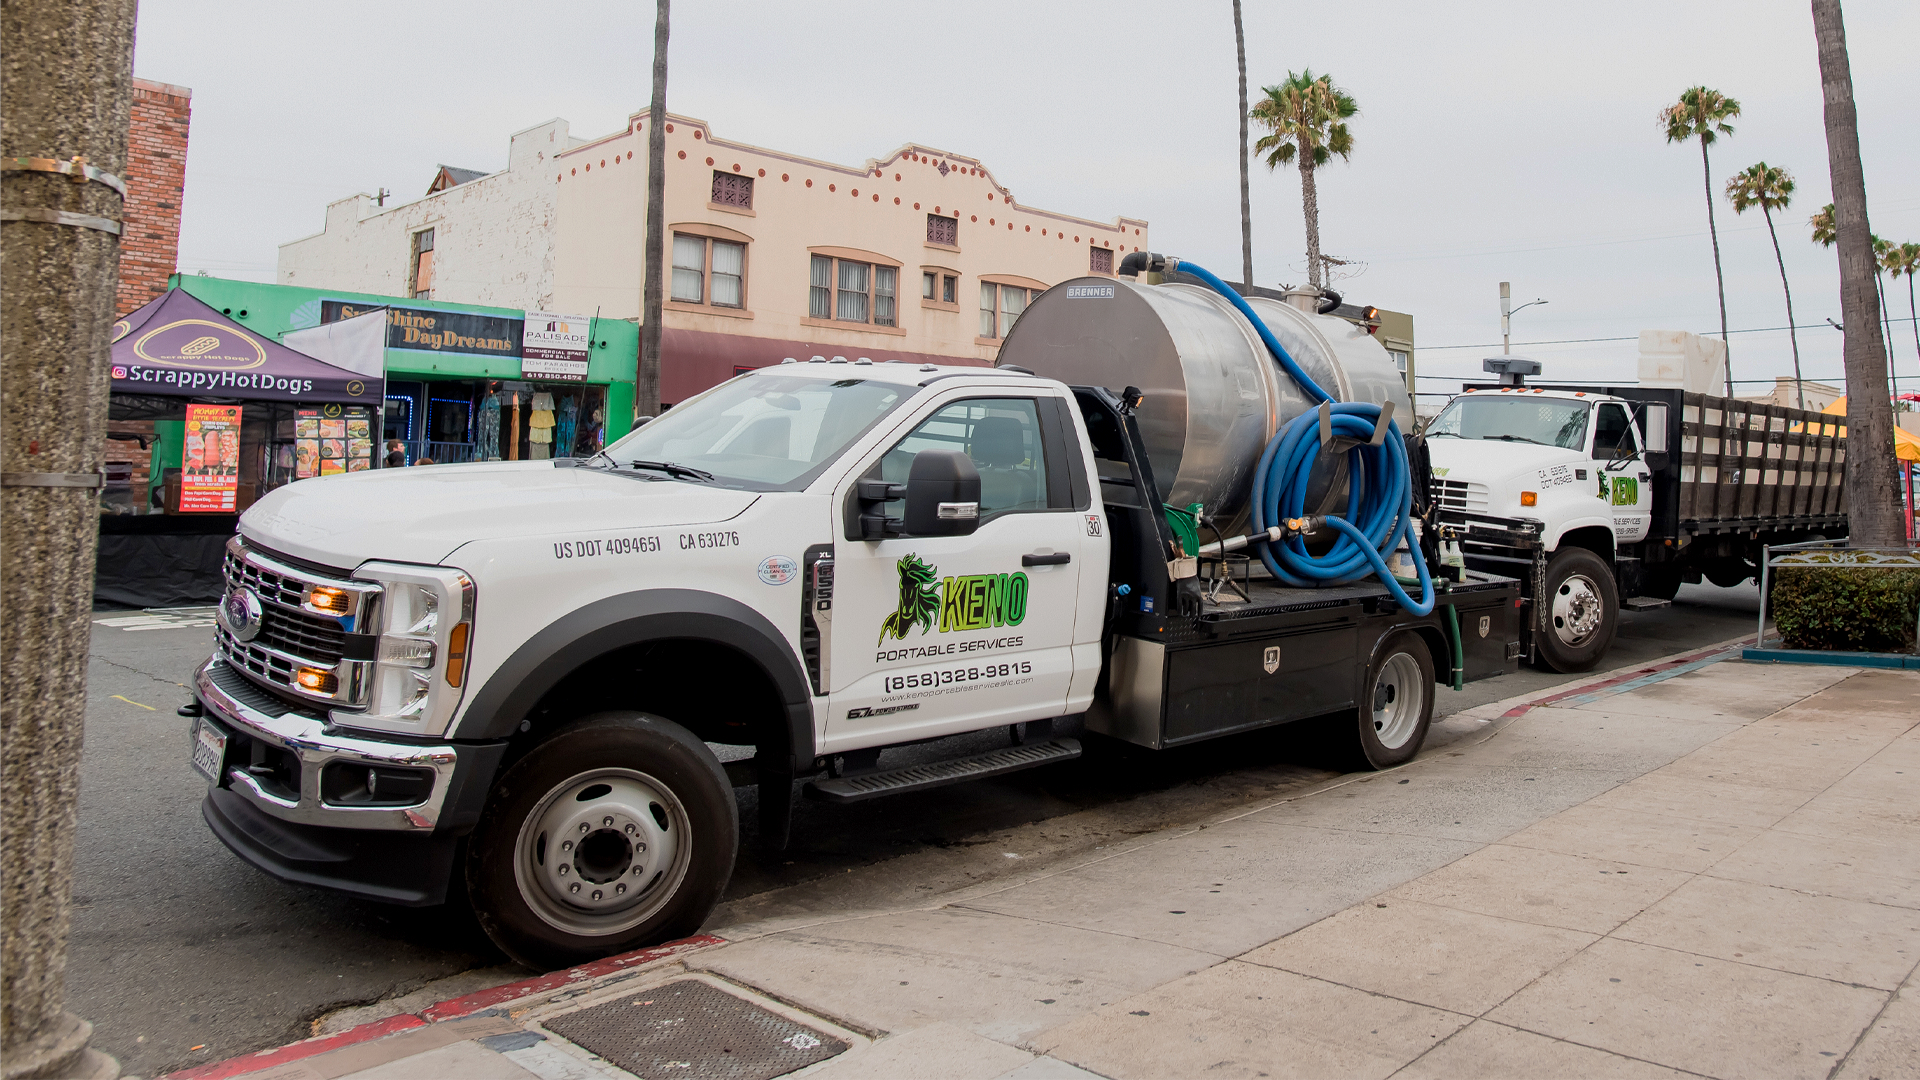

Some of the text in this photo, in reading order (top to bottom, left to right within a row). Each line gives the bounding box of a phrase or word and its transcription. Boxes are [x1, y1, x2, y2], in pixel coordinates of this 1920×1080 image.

[1068, 287, 1113, 297] BRENNER
[402, 326, 513, 351] DayDreams
[526, 332, 587, 342] PALISADE
[129, 365, 313, 395] ScrappyHotDogs
[193, 407, 225, 416] MOMMY'S
[1611, 476, 1638, 506] KENO
[1088, 520, 1100, 535] 30
[1621, 517, 1641, 526] SERVICES
[553, 535, 662, 559] US DOT 4094651
[679, 530, 740, 550] CA 631276
[819, 551, 832, 559] XL
[817, 565, 834, 611] F550
[939, 571, 1029, 634] KENO
[875, 635, 1025, 664] PORTABLE SERVICES
[884, 660, 1033, 694] (858)328-9815
[847, 706, 875, 720] 6.7L
[875, 706, 897, 715] POWER
